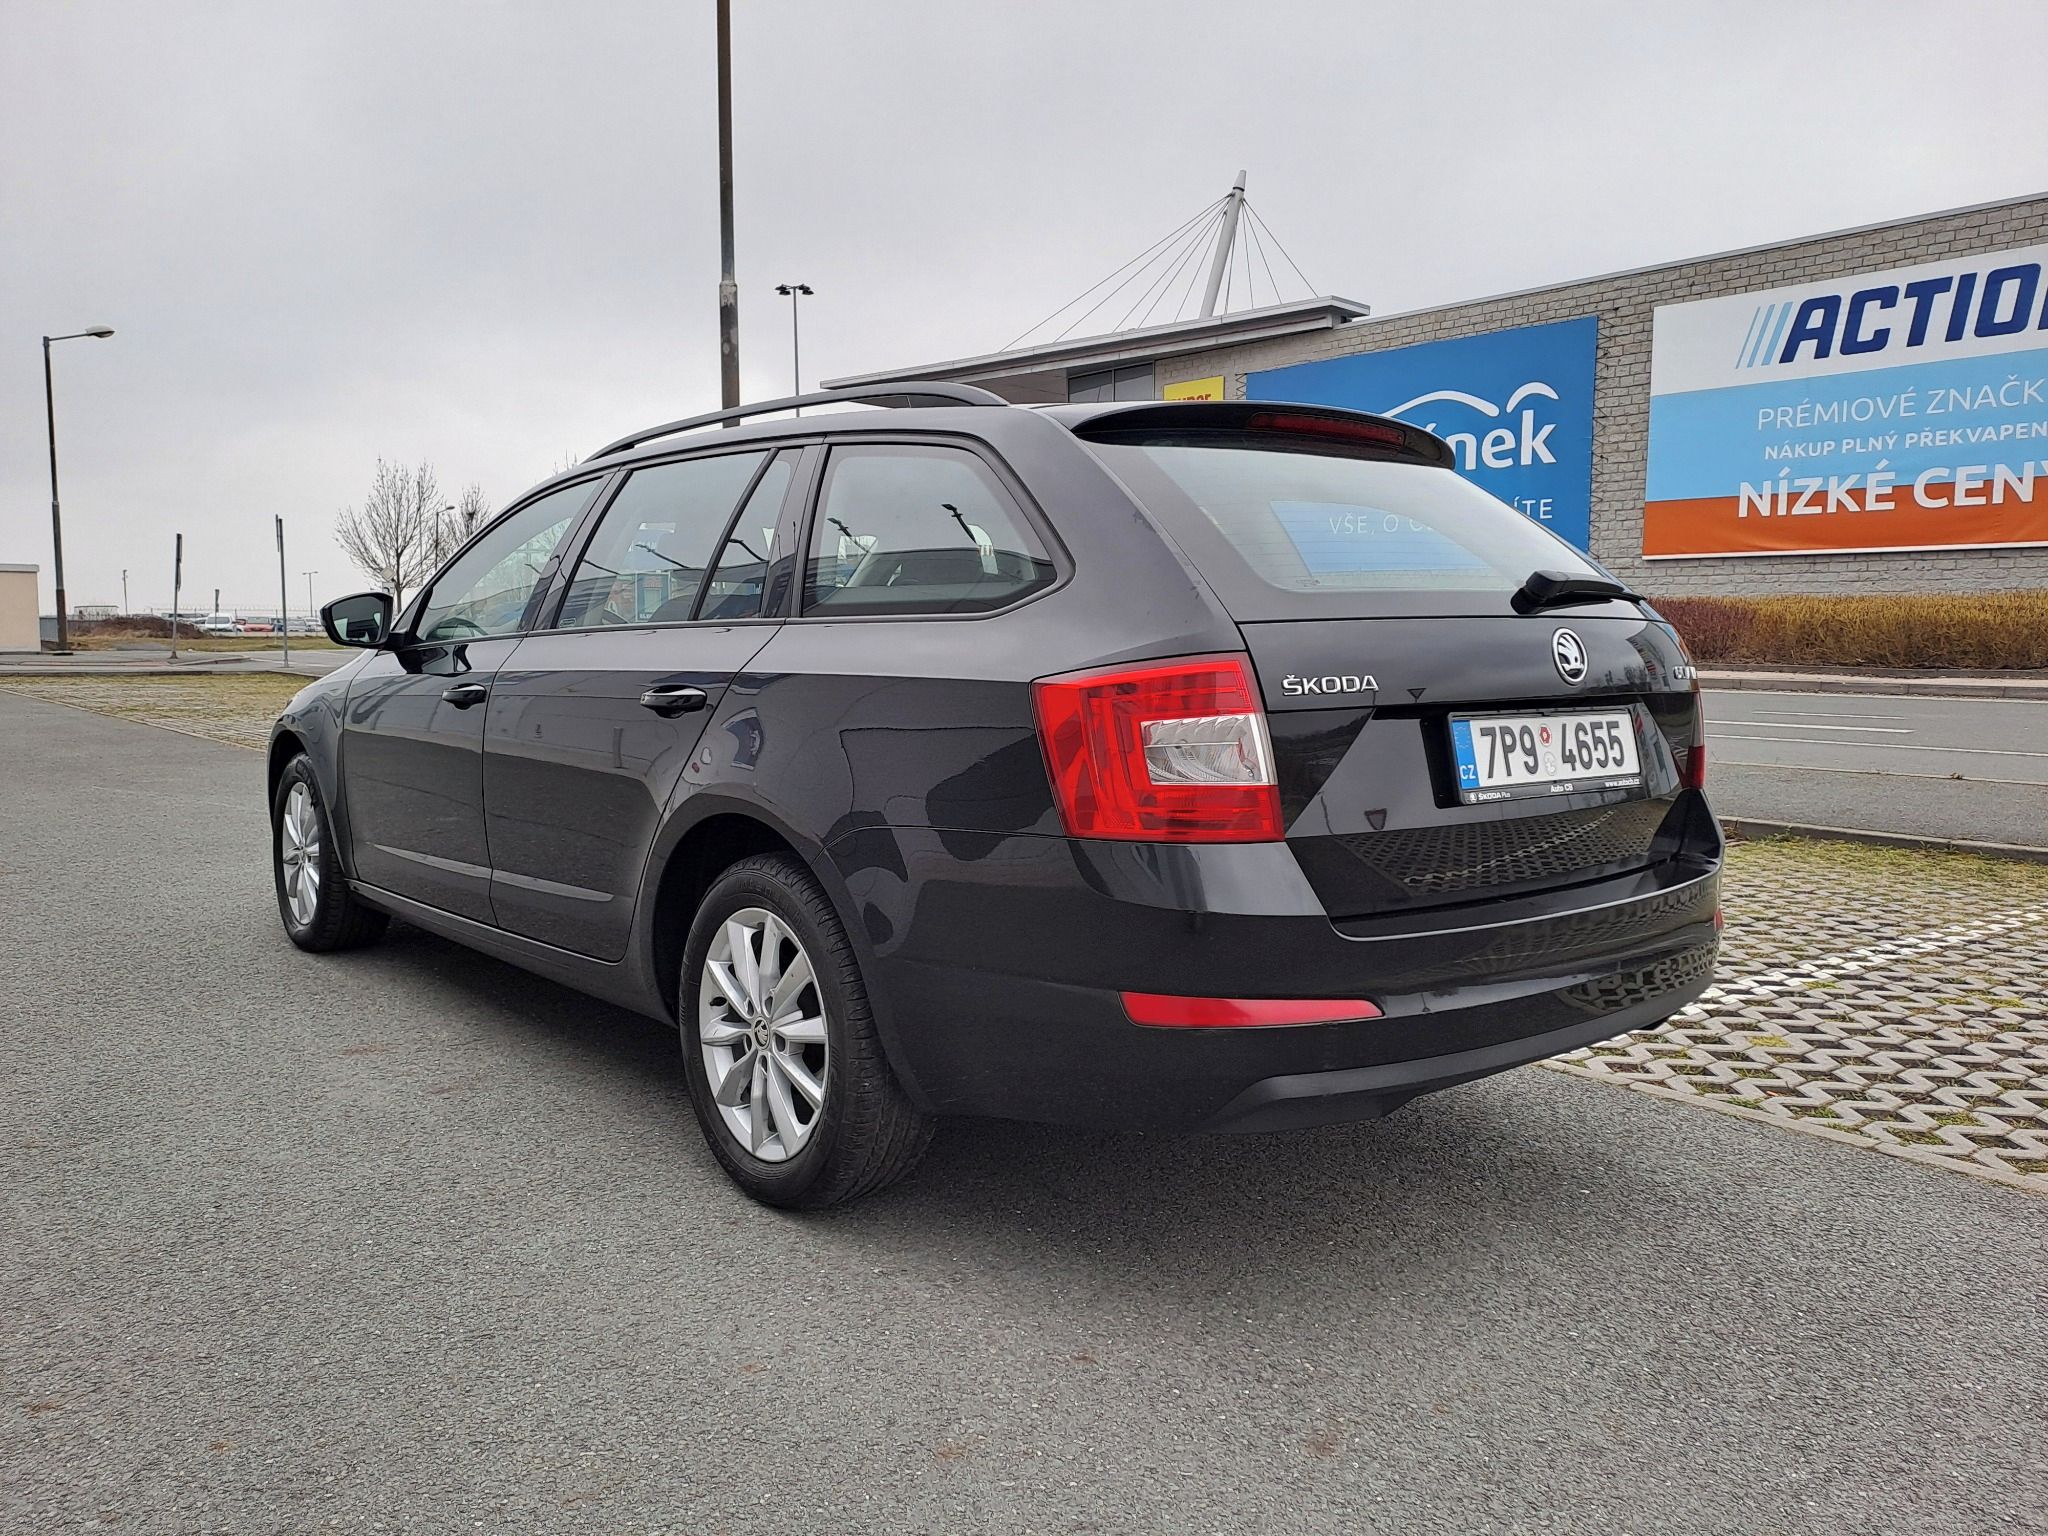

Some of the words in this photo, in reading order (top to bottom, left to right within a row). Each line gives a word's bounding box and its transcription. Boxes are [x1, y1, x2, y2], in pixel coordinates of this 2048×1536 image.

[1779, 263, 2048, 364] ACTIO
[1758, 388, 1917, 431] PRÉMIOVÉ
[1926, 375, 2045, 415] ZNAČK
[1425, 409, 1557, 471] nek
[1764, 439, 1836, 460] NÁKUP
[1842, 430, 1898, 454] PLNÝ
[1905, 421, 2048, 449] PŘEKVAPEN
[1738, 459, 1896, 519] NÍZKÉ
[1913, 462, 2048, 510] CEN
[1282, 674, 1379, 696] ŠKODA
[1459, 764, 1477, 780] CZ
[1480, 725, 1539, 779] 7P9
[1561, 720, 1625, 771] 4655
[1478, 791, 1501, 801] ŠKODA
